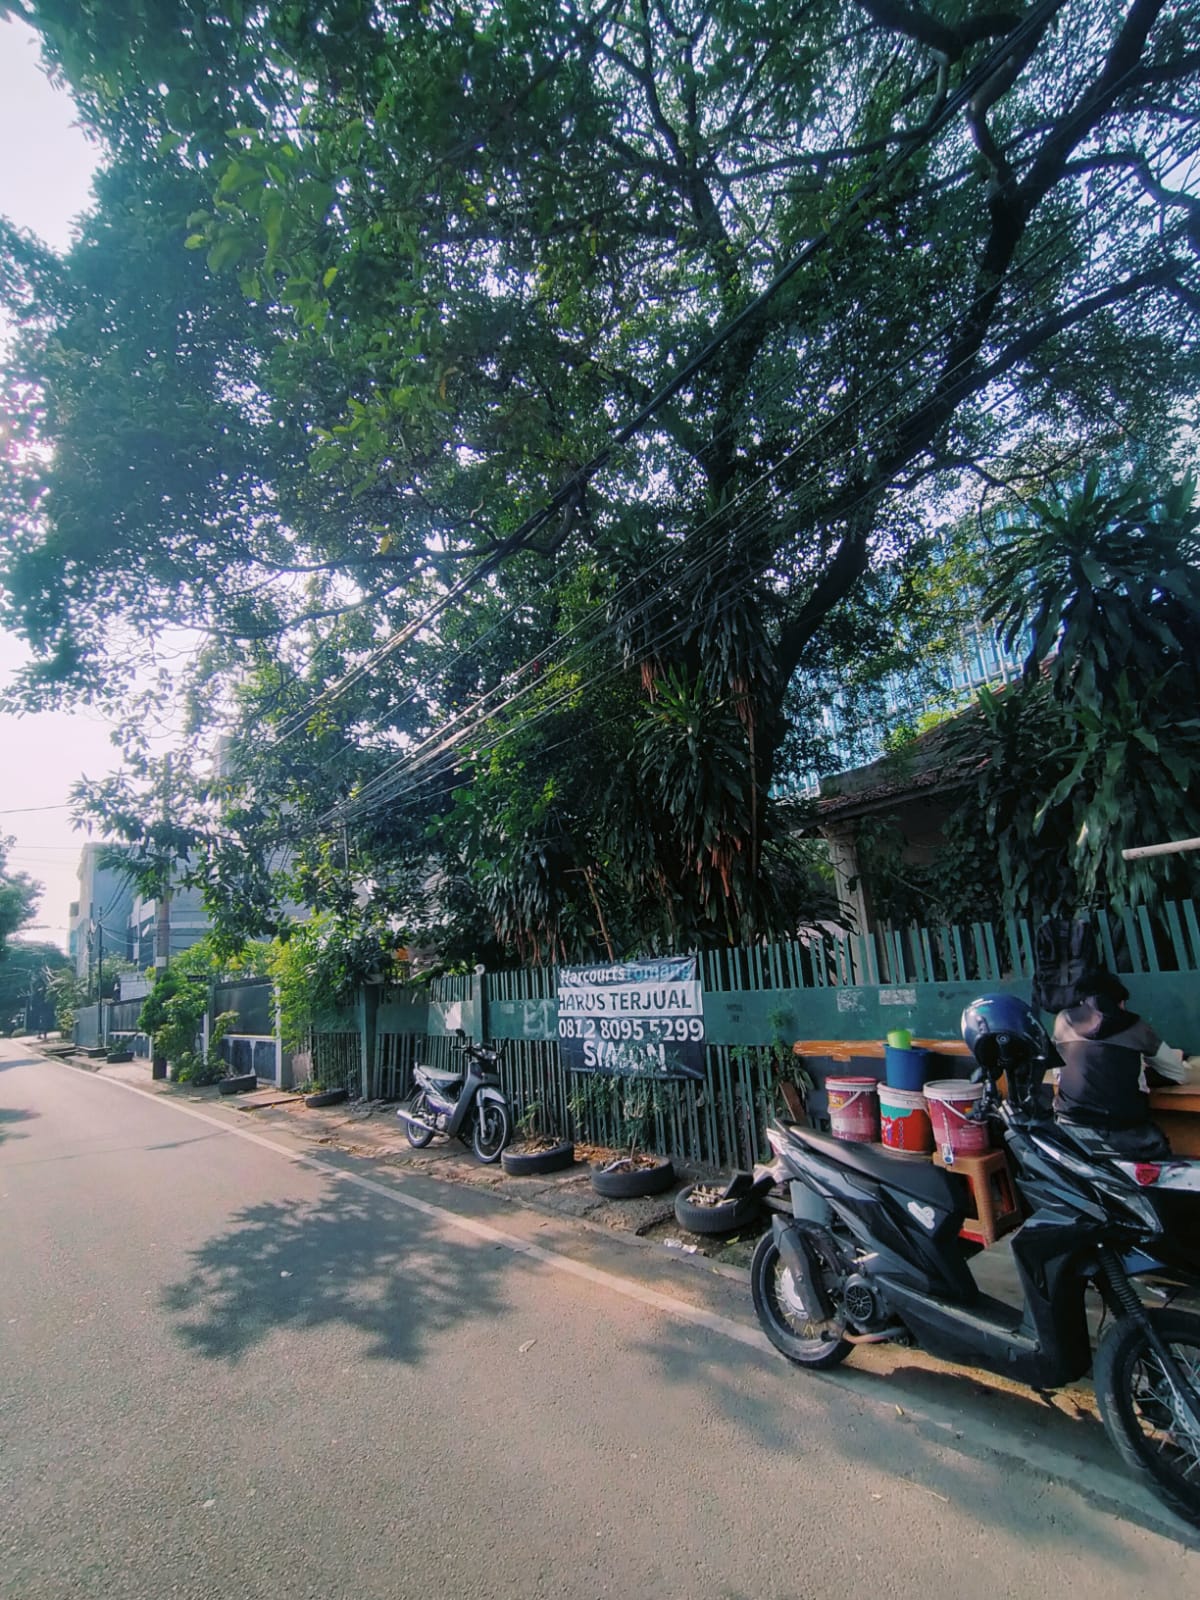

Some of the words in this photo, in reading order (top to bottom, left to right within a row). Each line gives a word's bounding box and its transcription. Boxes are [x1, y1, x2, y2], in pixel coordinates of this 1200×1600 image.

[560, 994, 605, 1011] HARUS
[609, 989, 692, 1010] TERJUAL
[558, 1018, 596, 1038] 0812
[601, 1019, 644, 1040] 8095
[649, 1018, 704, 1042] 5299
